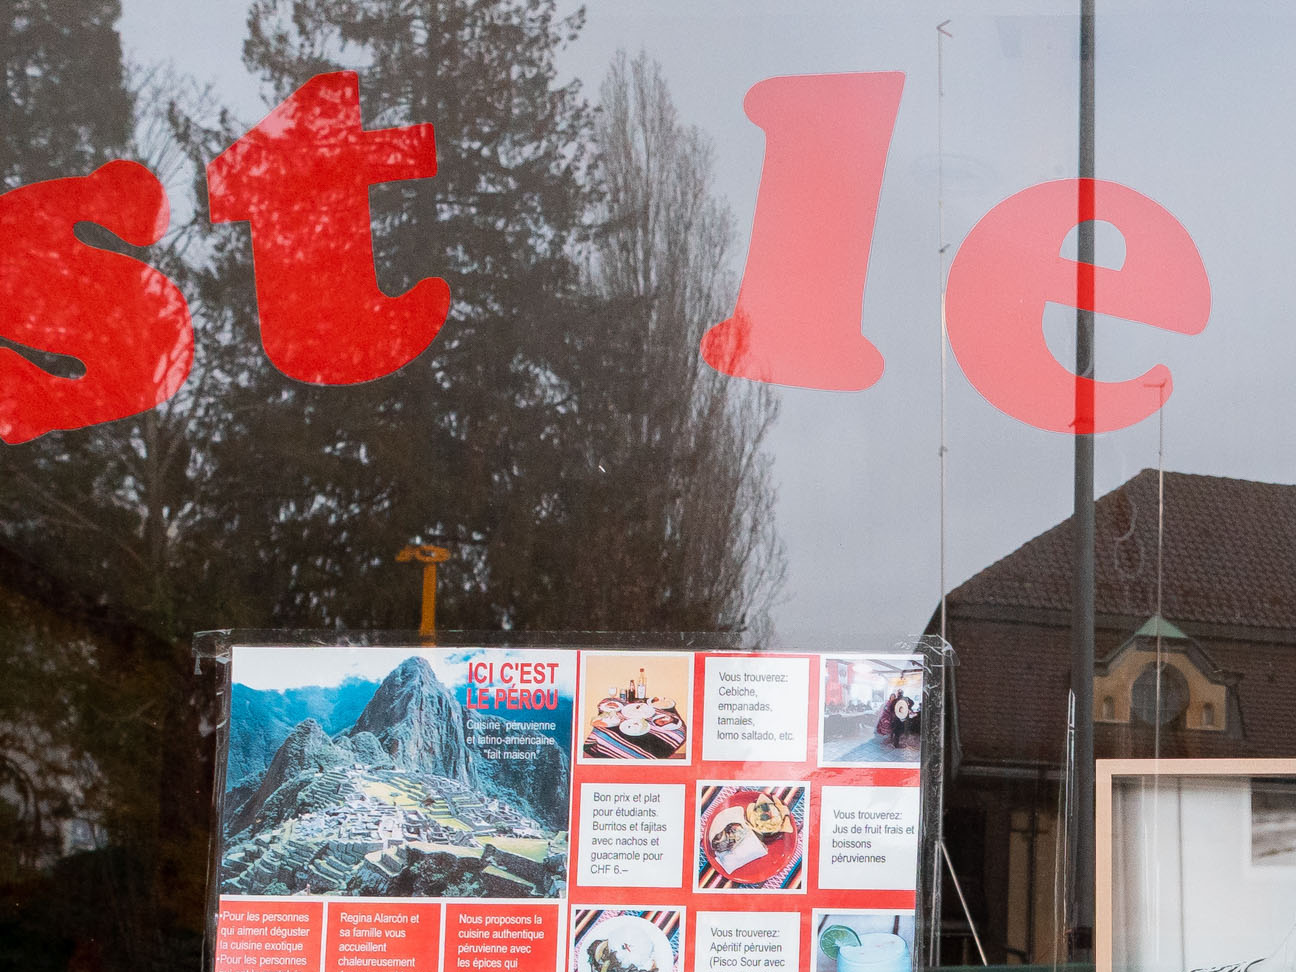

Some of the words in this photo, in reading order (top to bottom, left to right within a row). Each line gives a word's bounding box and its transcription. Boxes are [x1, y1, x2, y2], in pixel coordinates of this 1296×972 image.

[0, 70, 452, 445] st
[700, 71, 1212, 436] le
[468, 662, 493, 683] ICI
[500, 662, 559, 683] C'EST
[719, 671, 741, 682] Vous
[743, 671, 788, 682] trouverez:
[467, 687, 490, 708] LE
[495, 682, 558, 709] PÉROU
[719, 686, 757, 697] Cebiche,
[718, 701, 773, 712] empanadas,
[467, 719, 500, 729] Cuisine
[506, 720, 556, 732] péruvienne
[467, 735, 475, 744] et
[478, 734, 555, 745] latino-américaine
[741, 730, 776, 741] saltado,
[594, 791, 610, 802] Bon
[613, 792, 630, 804] prix
[633, 793, 641, 802] et
[644, 792, 660, 804] plat
[593, 808, 612, 818] pour
[833, 809, 855, 819] Vous
[858, 810, 902, 820] trouverez:
[593, 821, 626, 831] Burritos
[629, 822, 638, 831] et
[640, 821, 666, 833] fajitas
[833, 823, 848, 834] Jus
[851, 823, 862, 834] de
[865, 823, 882, 834] fruit
[884, 823, 903, 834] frais
[906, 824, 914, 834] et
[592, 837, 612, 845] avec
[616, 835, 648, 845] nachos
[651, 836, 659, 845] et
[832, 838, 871, 848] boissons
[591, 850, 640, 861] guacamole
[643, 852, 662, 862] pour
[832, 852, 886, 864] péruviennes
[591, 864, 610, 874] CHF
[247, 911, 259, 921] les
[262, 913, 309, 923] personnes
[340, 912, 371, 924] Regina
[374, 912, 408, 923] Alarcón
[411, 914, 419, 923] et
[459, 913, 481, 923] Nous
[485, 915, 530, 926] proposons
[534, 914, 542, 924] la
[221, 925, 234, 937] qui
[237, 925, 266, 935] aiment
[270, 926, 310, 938] déguster
[340, 928, 349, 937] sa
[353, 926, 382, 937] famille
[385, 928, 405, 937] vous
[458, 928, 490, 938] cuisine
[493, 928, 544, 940] authentique
[711, 927, 732, 937] Vous
[736, 928, 780, 937] trouverez:
[220, 940, 227, 949] la
[230, 940, 261, 949] cuisine
[265, 940, 303, 952] exotique
[339, 941, 386, 951] accueillent
[458, 942, 506, 955] péruvienne
[510, 944, 531, 953] avec
[710, 941, 741, 954] Apéritif
[743, 941, 782, 954] péruvien
[244, 954, 256, 964] les
[260, 956, 306, 966] personnes
[338, 956, 415, 966] chaleureusement
[457, 957, 470, 967] les
[473, 957, 501, 969] épices
[505, 957, 518, 970] qui
[709, 955, 737, 968] (Pisco
[741, 956, 760, 966] Sour
[764, 958, 785, 966] avec
